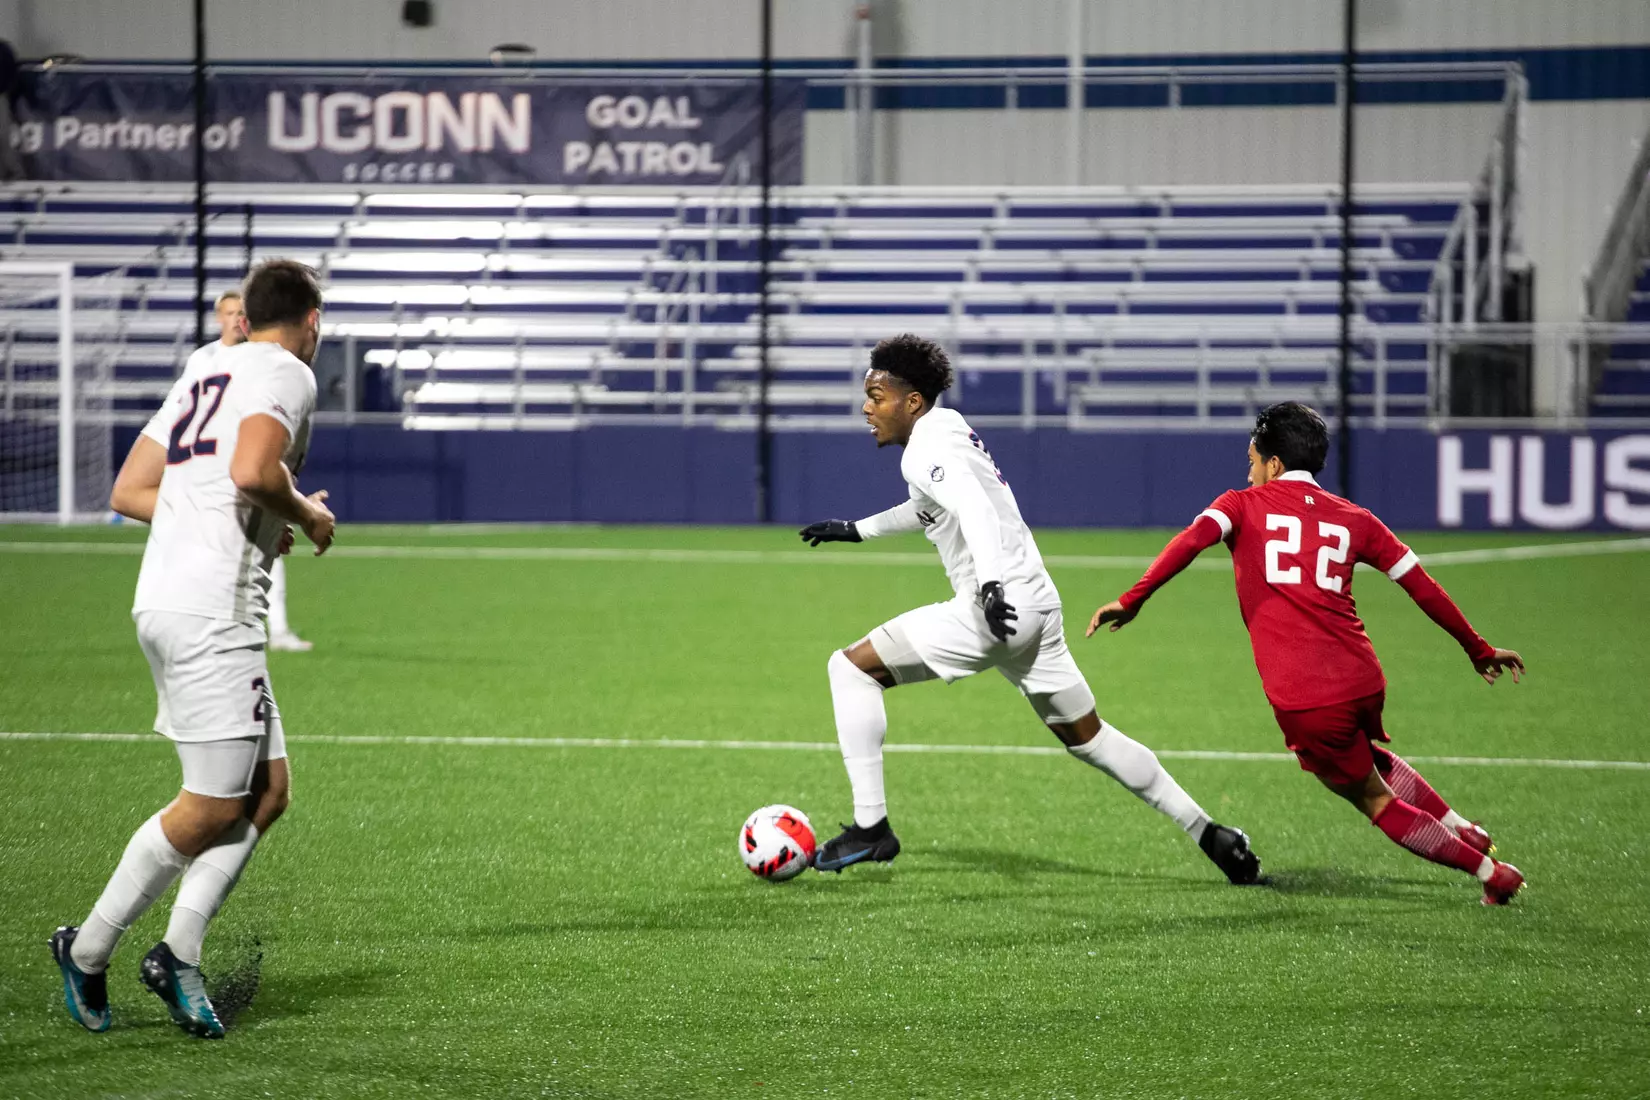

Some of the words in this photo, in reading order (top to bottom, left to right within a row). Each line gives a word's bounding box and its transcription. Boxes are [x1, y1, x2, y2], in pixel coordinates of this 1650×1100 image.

[267, 91, 532, 153] UCONN
[585, 94, 702, 129] GOAL
[53, 116, 196, 150] Partner
[203, 116, 246, 150] of
[343, 162, 455, 182] SOCCER
[563, 140, 725, 176] PATROL
[1438, 435, 1650, 528] HUS
[1304, 495, 1316, 505] R
[1265, 513, 1350, 593] 22
